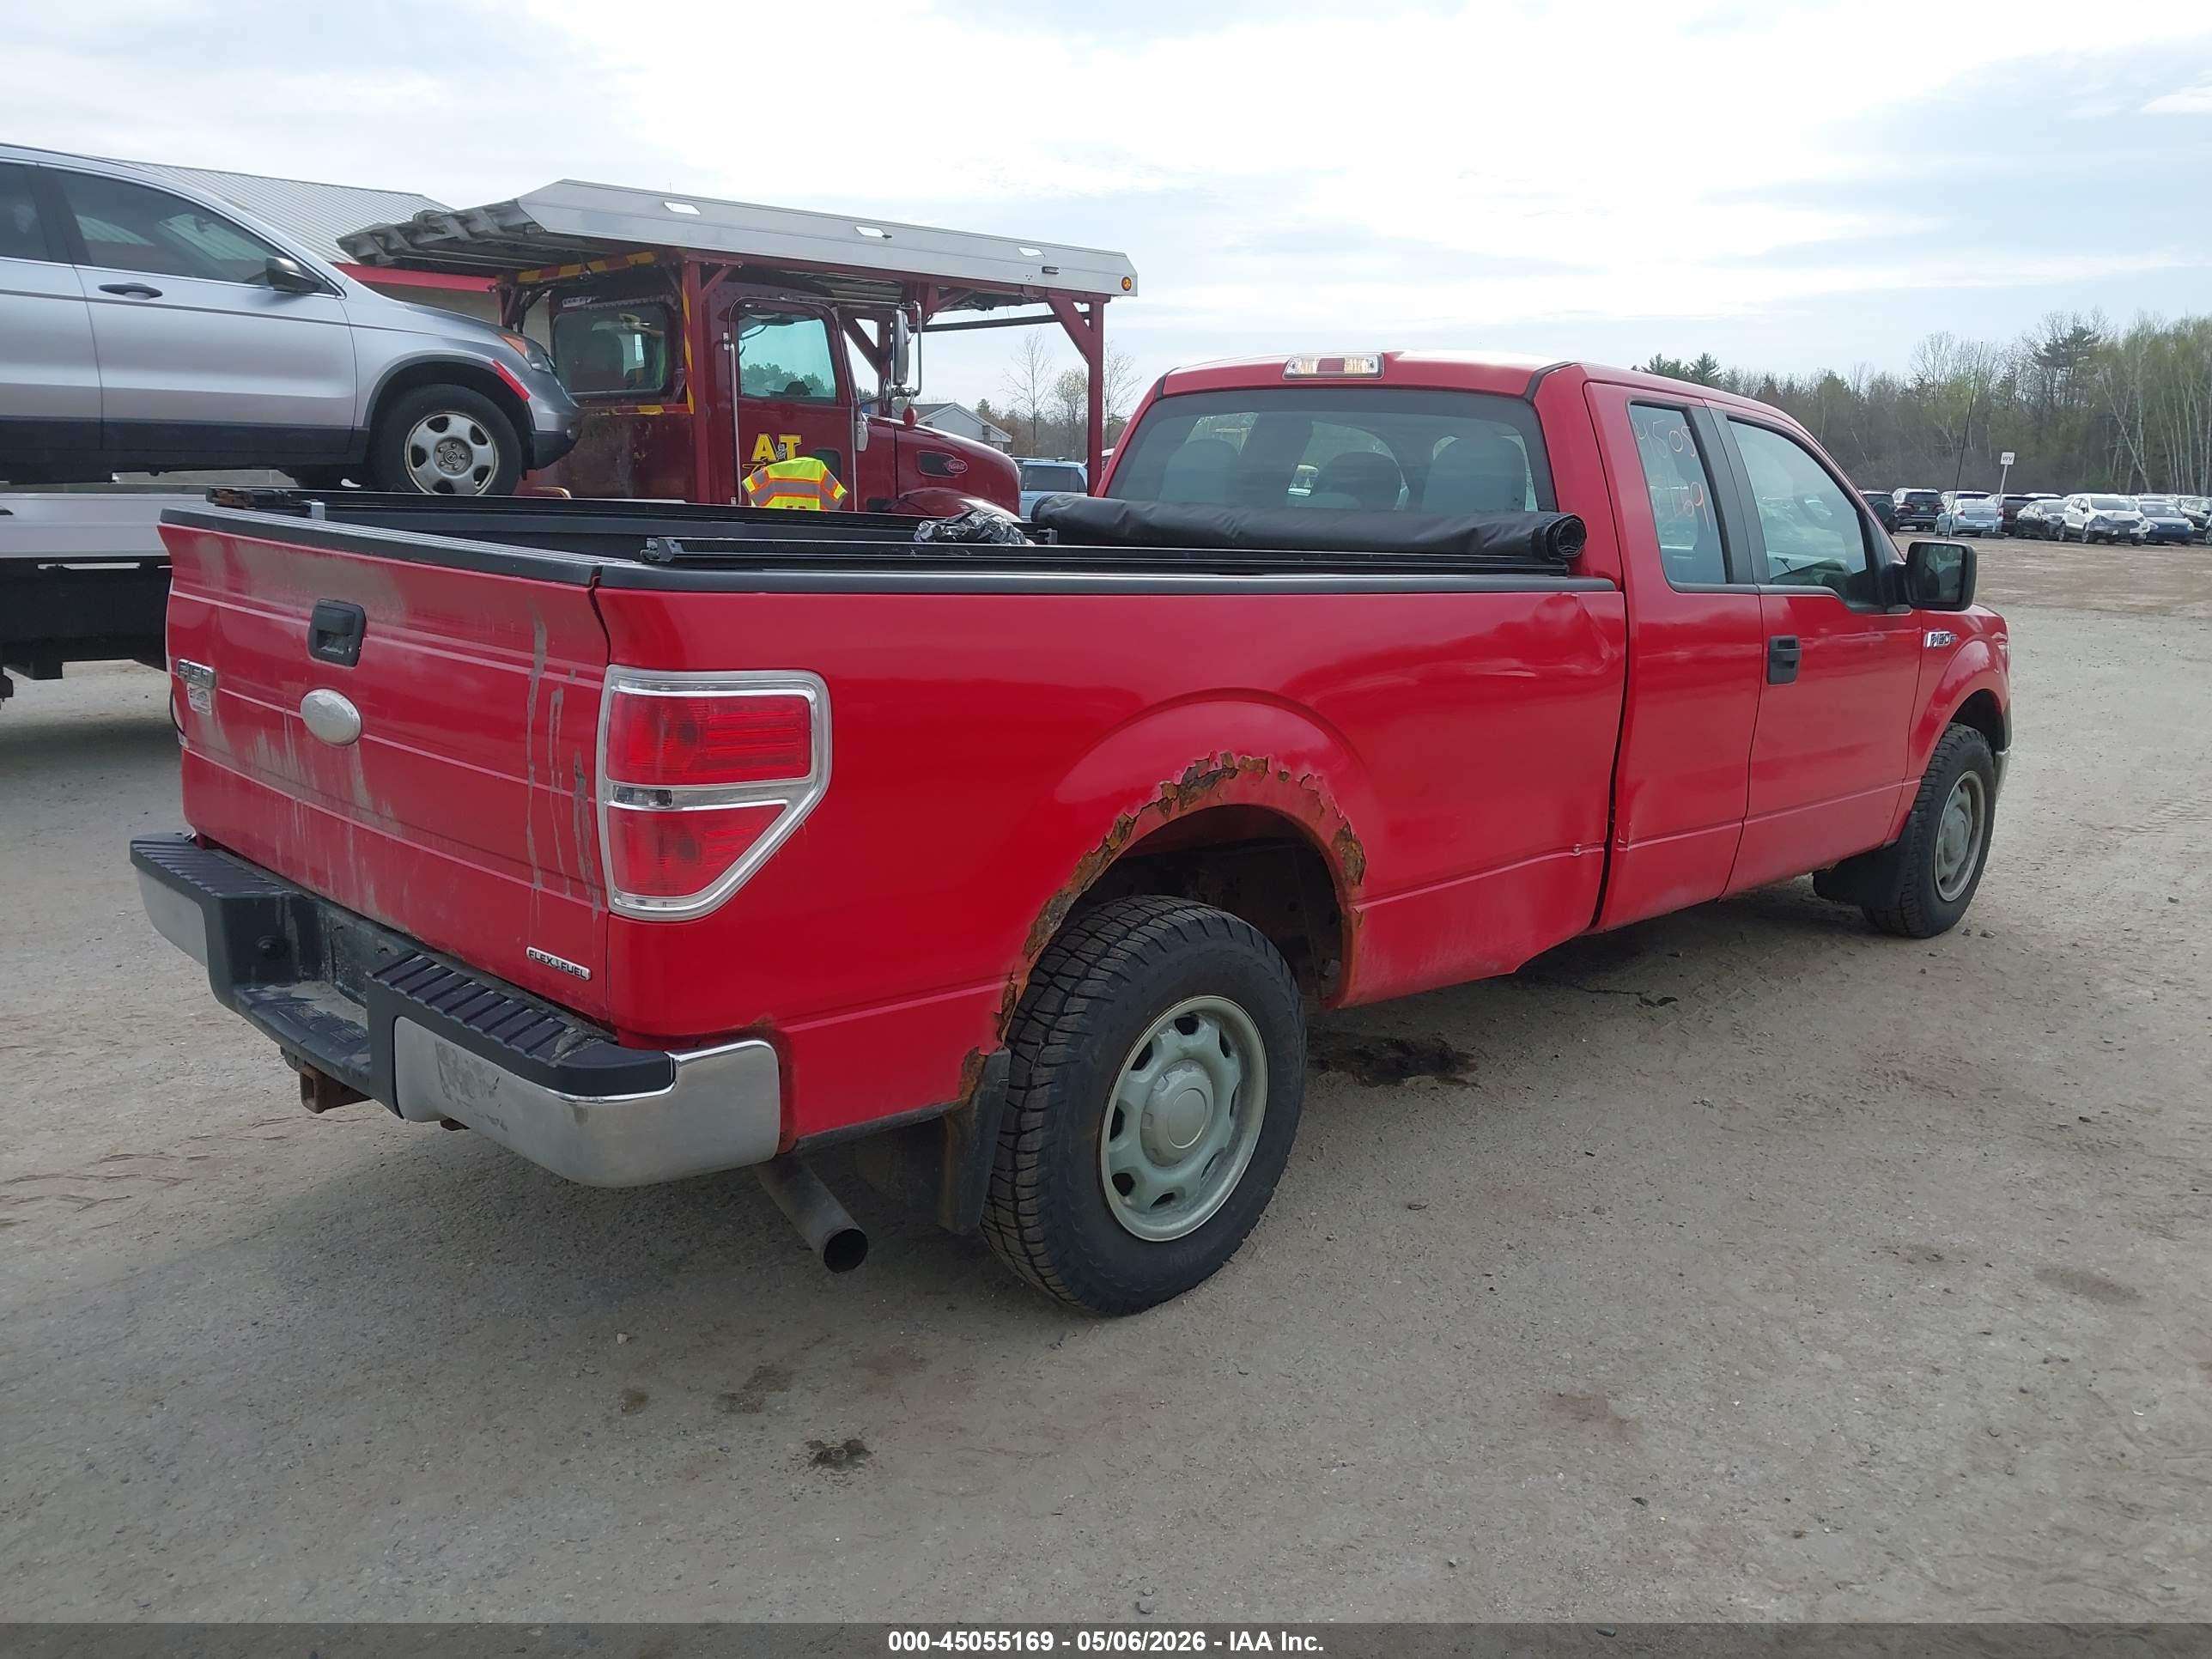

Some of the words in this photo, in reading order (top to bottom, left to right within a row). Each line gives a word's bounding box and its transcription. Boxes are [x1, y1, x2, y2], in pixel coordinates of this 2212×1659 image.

[1634, 419, 1697, 459] 4505
[528, 949, 555, 967] FLEX
[561, 962, 586, 979] FUEL
